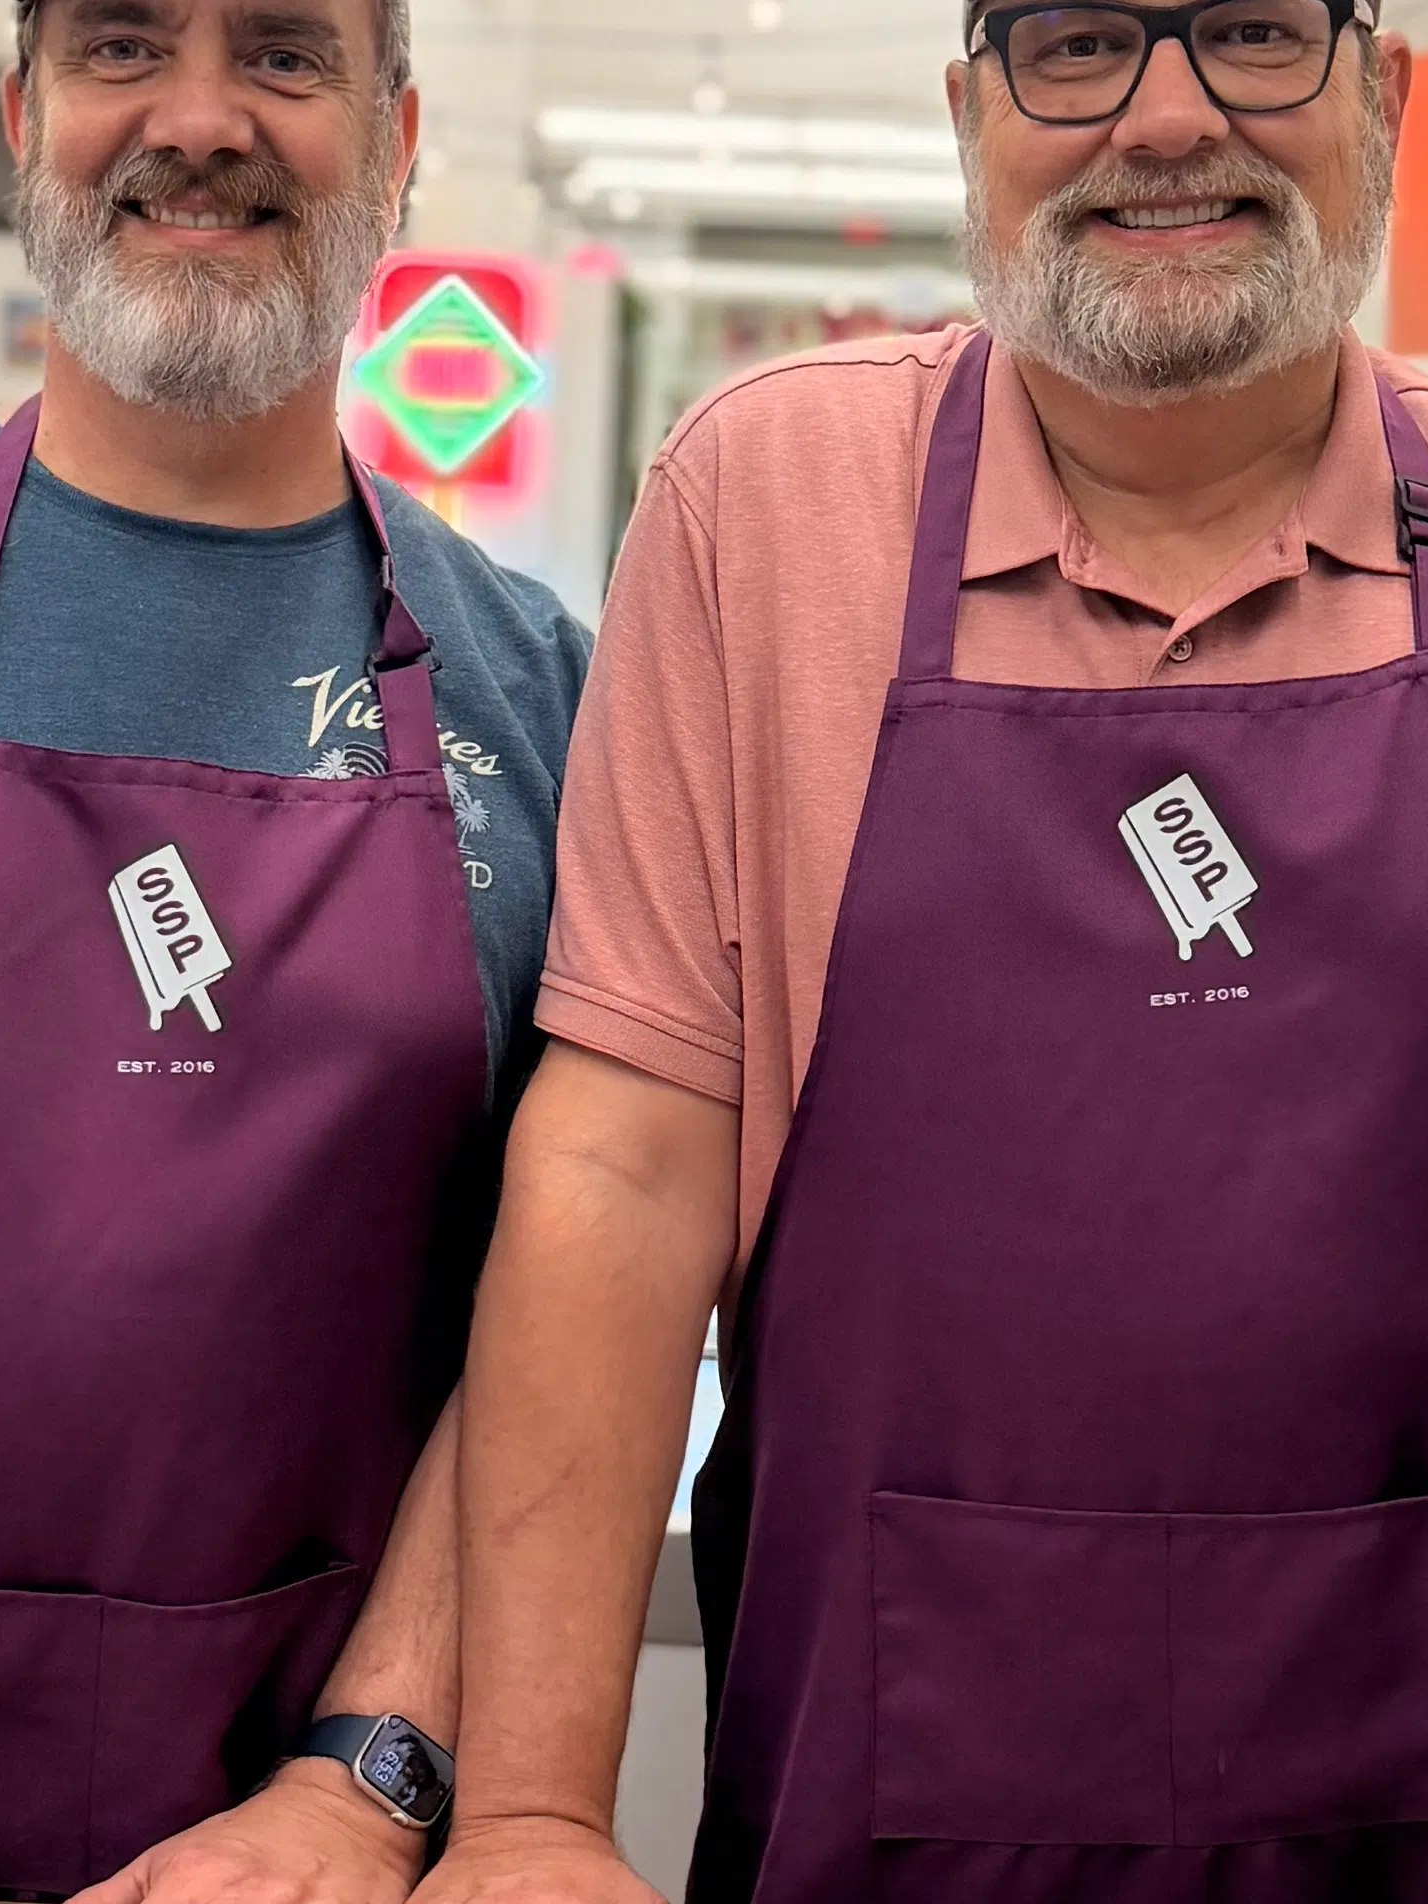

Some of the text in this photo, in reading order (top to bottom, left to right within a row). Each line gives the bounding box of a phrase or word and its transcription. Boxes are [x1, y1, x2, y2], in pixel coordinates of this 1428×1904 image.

[1153, 797, 1228, 902] SSP
[136, 866, 203, 974] SSP
[1150, 986, 1250, 1007] EST. 2016
[117, 1060, 216, 1073] EST. 2016
